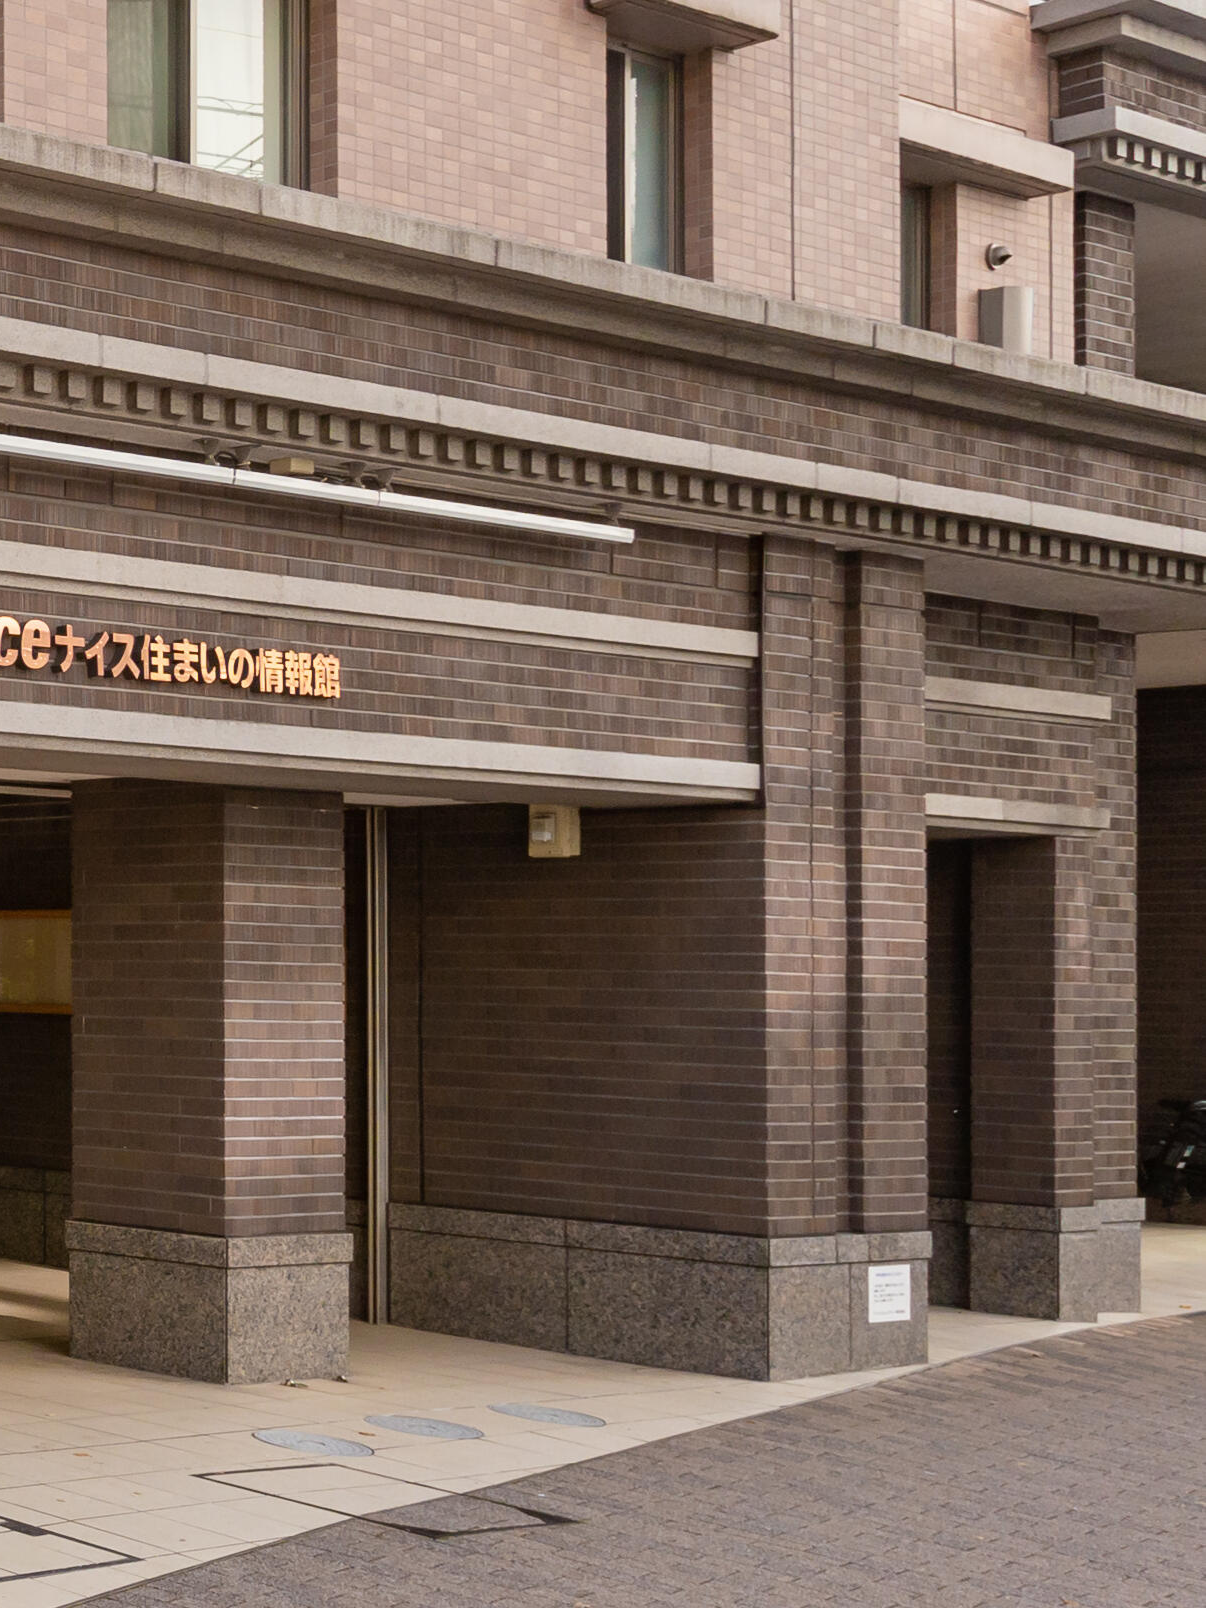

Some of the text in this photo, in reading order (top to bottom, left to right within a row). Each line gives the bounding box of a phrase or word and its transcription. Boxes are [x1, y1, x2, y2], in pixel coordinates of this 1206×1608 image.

[54, 623, 342, 699] ナイス住まいの情報館
